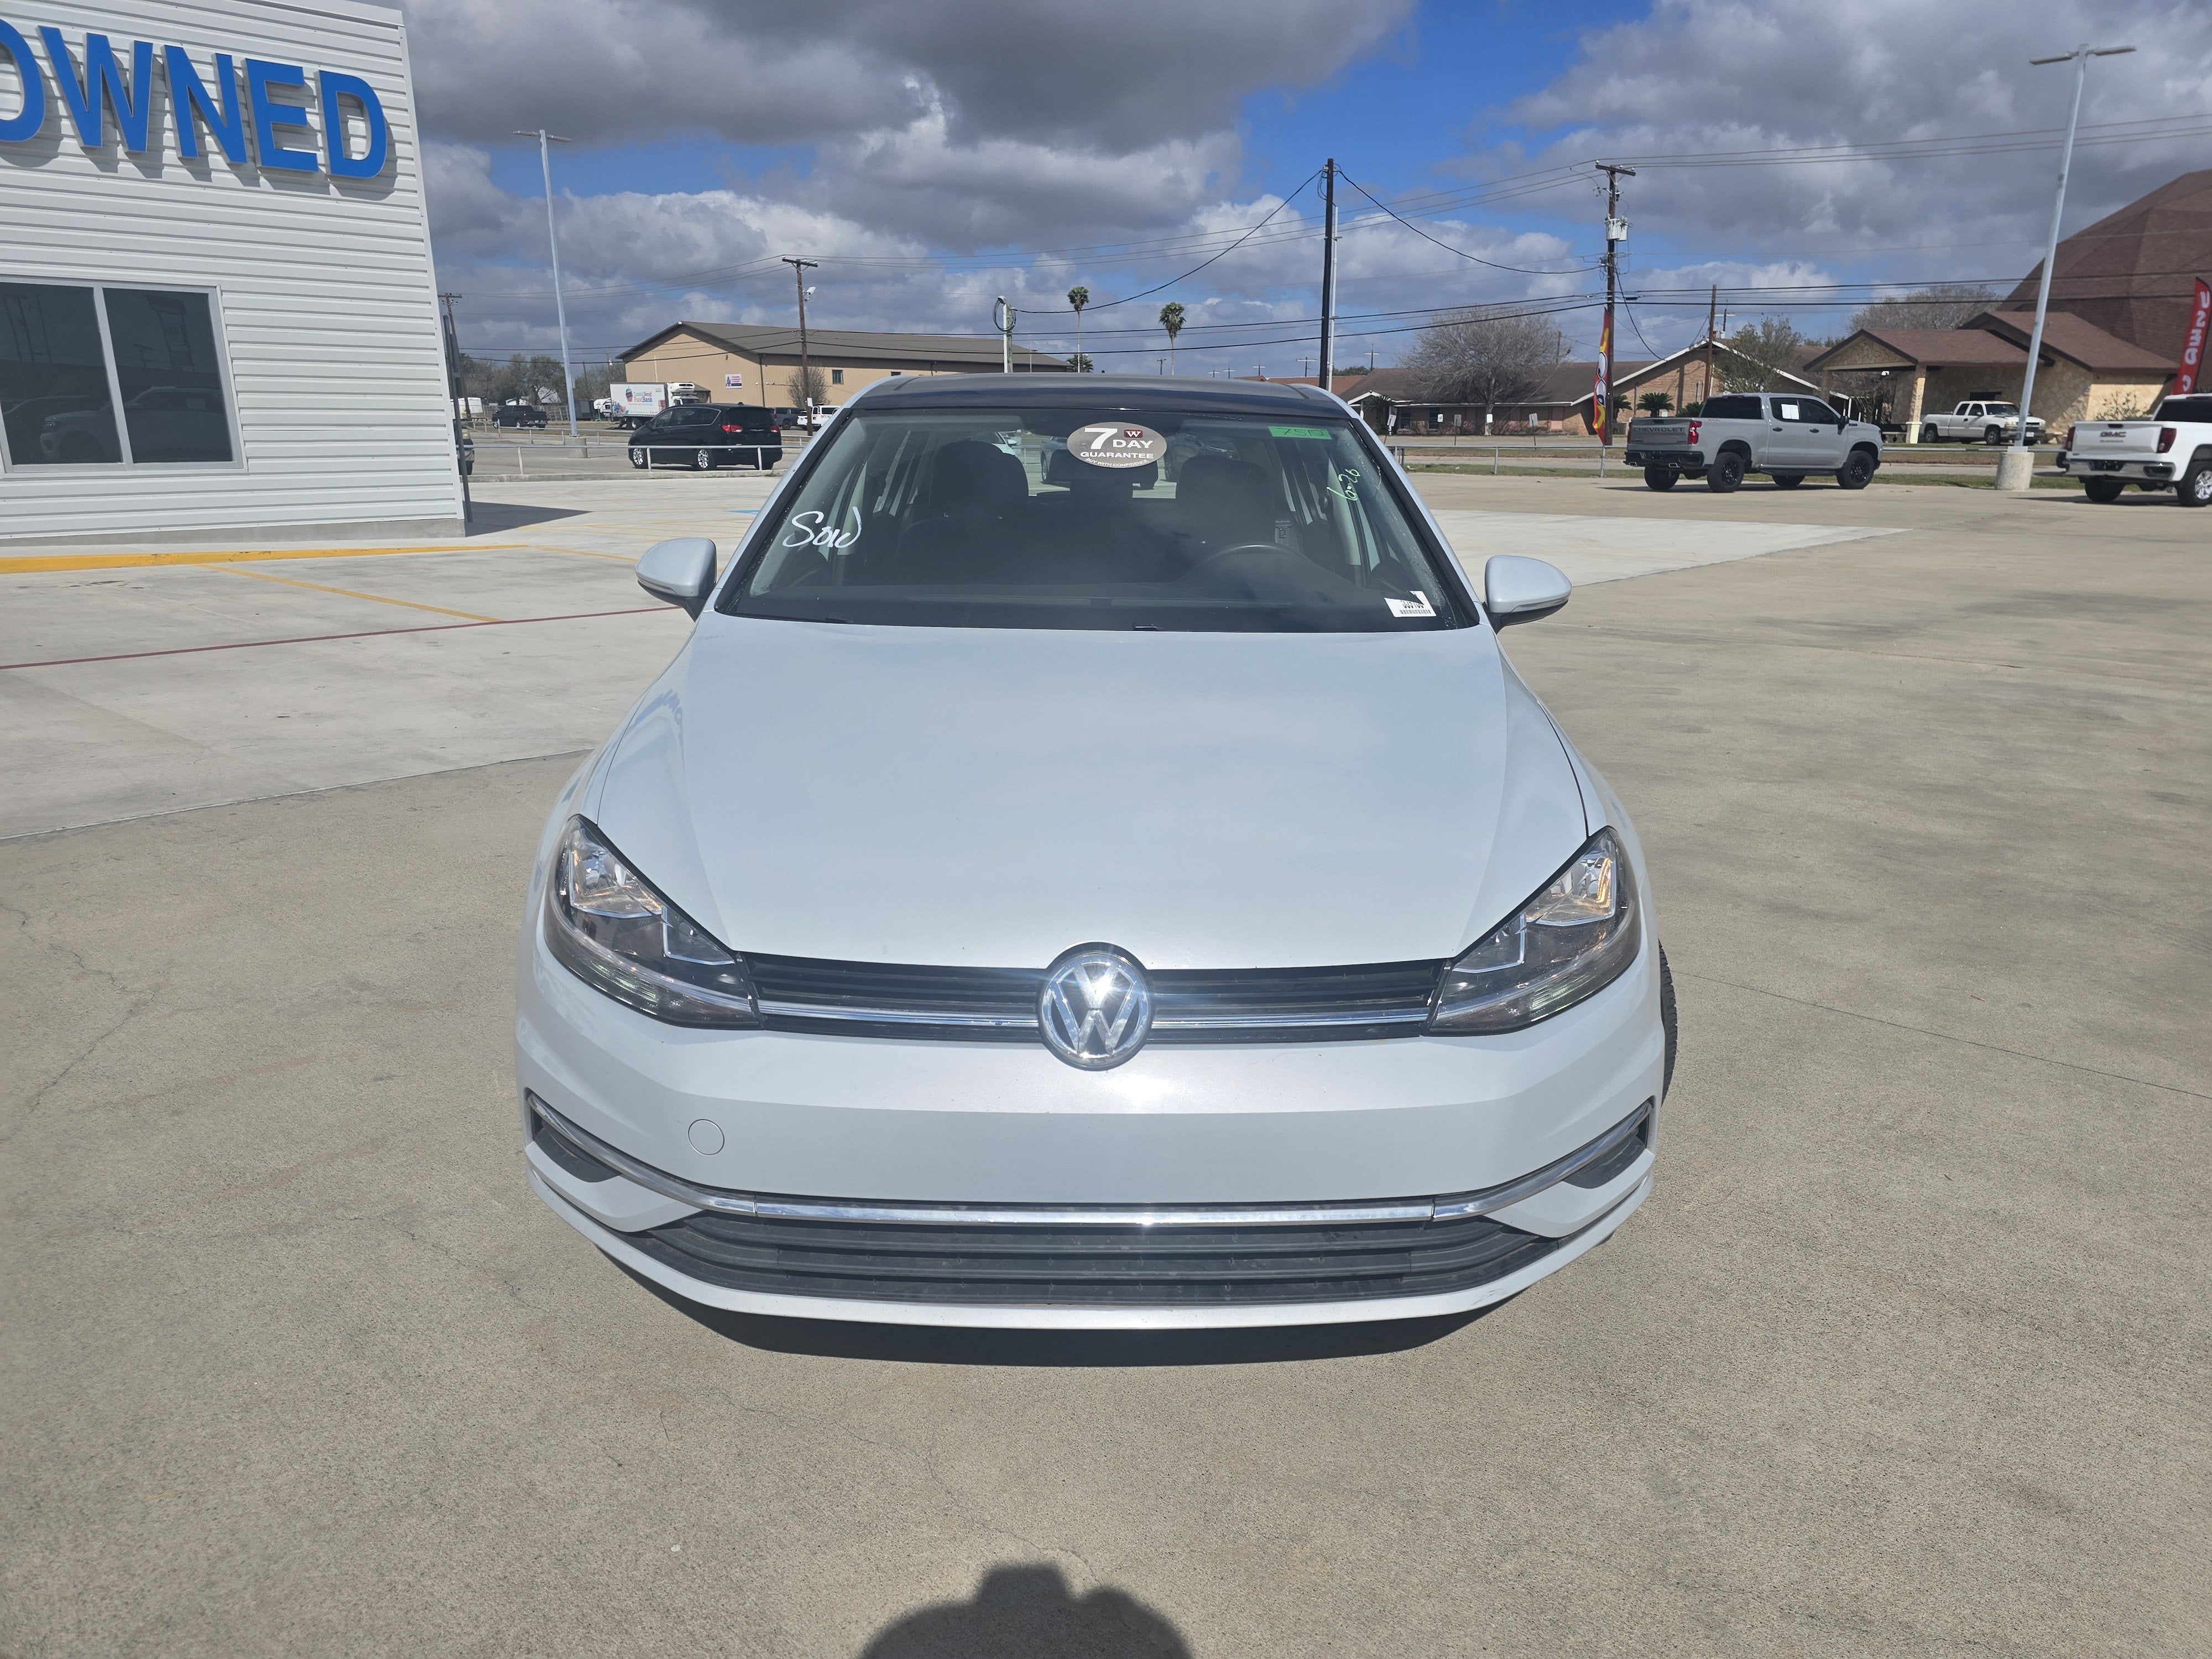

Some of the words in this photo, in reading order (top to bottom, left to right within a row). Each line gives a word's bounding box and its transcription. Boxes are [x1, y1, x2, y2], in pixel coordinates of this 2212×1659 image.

[1084, 427, 1118, 450] 7
[1113, 439, 1154, 448] DAY
[1113, 459, 1149, 467] CONFIDENCE
[782, 506, 862, 548] Sold
